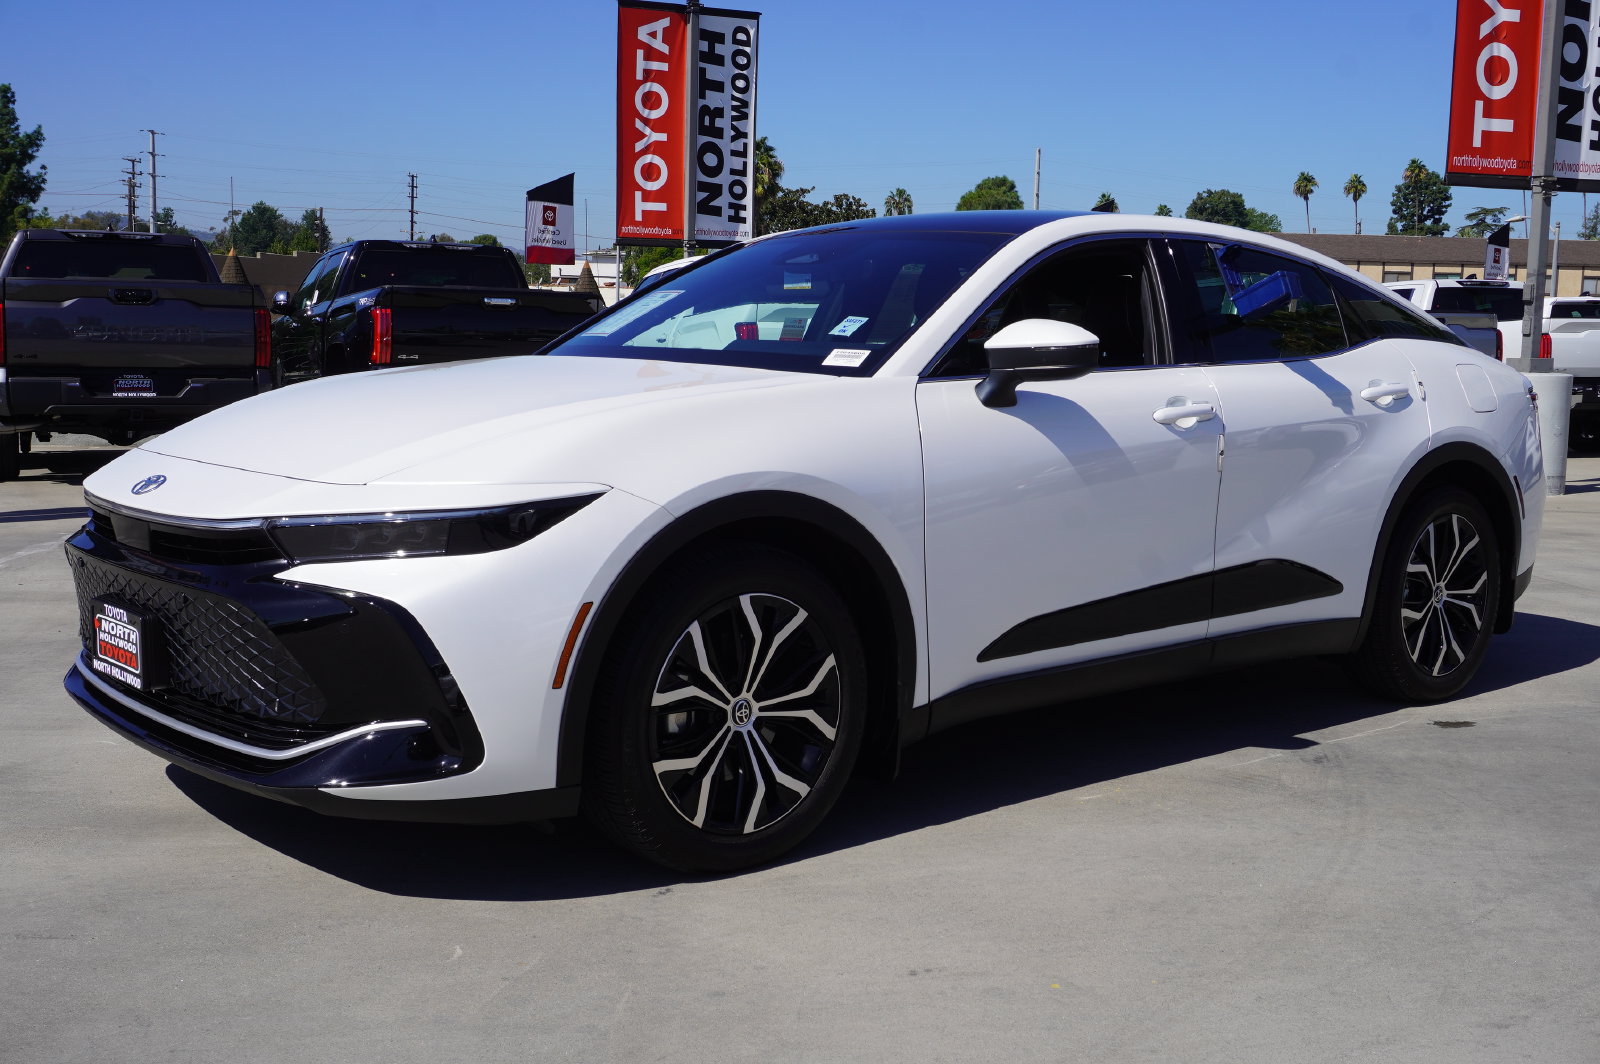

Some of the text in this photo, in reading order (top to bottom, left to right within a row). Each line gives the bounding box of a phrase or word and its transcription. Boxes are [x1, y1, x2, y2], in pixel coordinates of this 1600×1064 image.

[634, 16, 671, 222] TOYOTA
[696, 28, 726, 218] NORTH
[728, 25, 752, 225] HOLLYWOOD
[104, 603, 128, 623] TOYOTA
[99, 631, 136, 653] HOLLYWOOD
[101, 619, 136, 643] NORTH
[100, 640, 137, 669] TOYOTA
[93, 658, 142, 688] NORTH HOLLYWOOD
